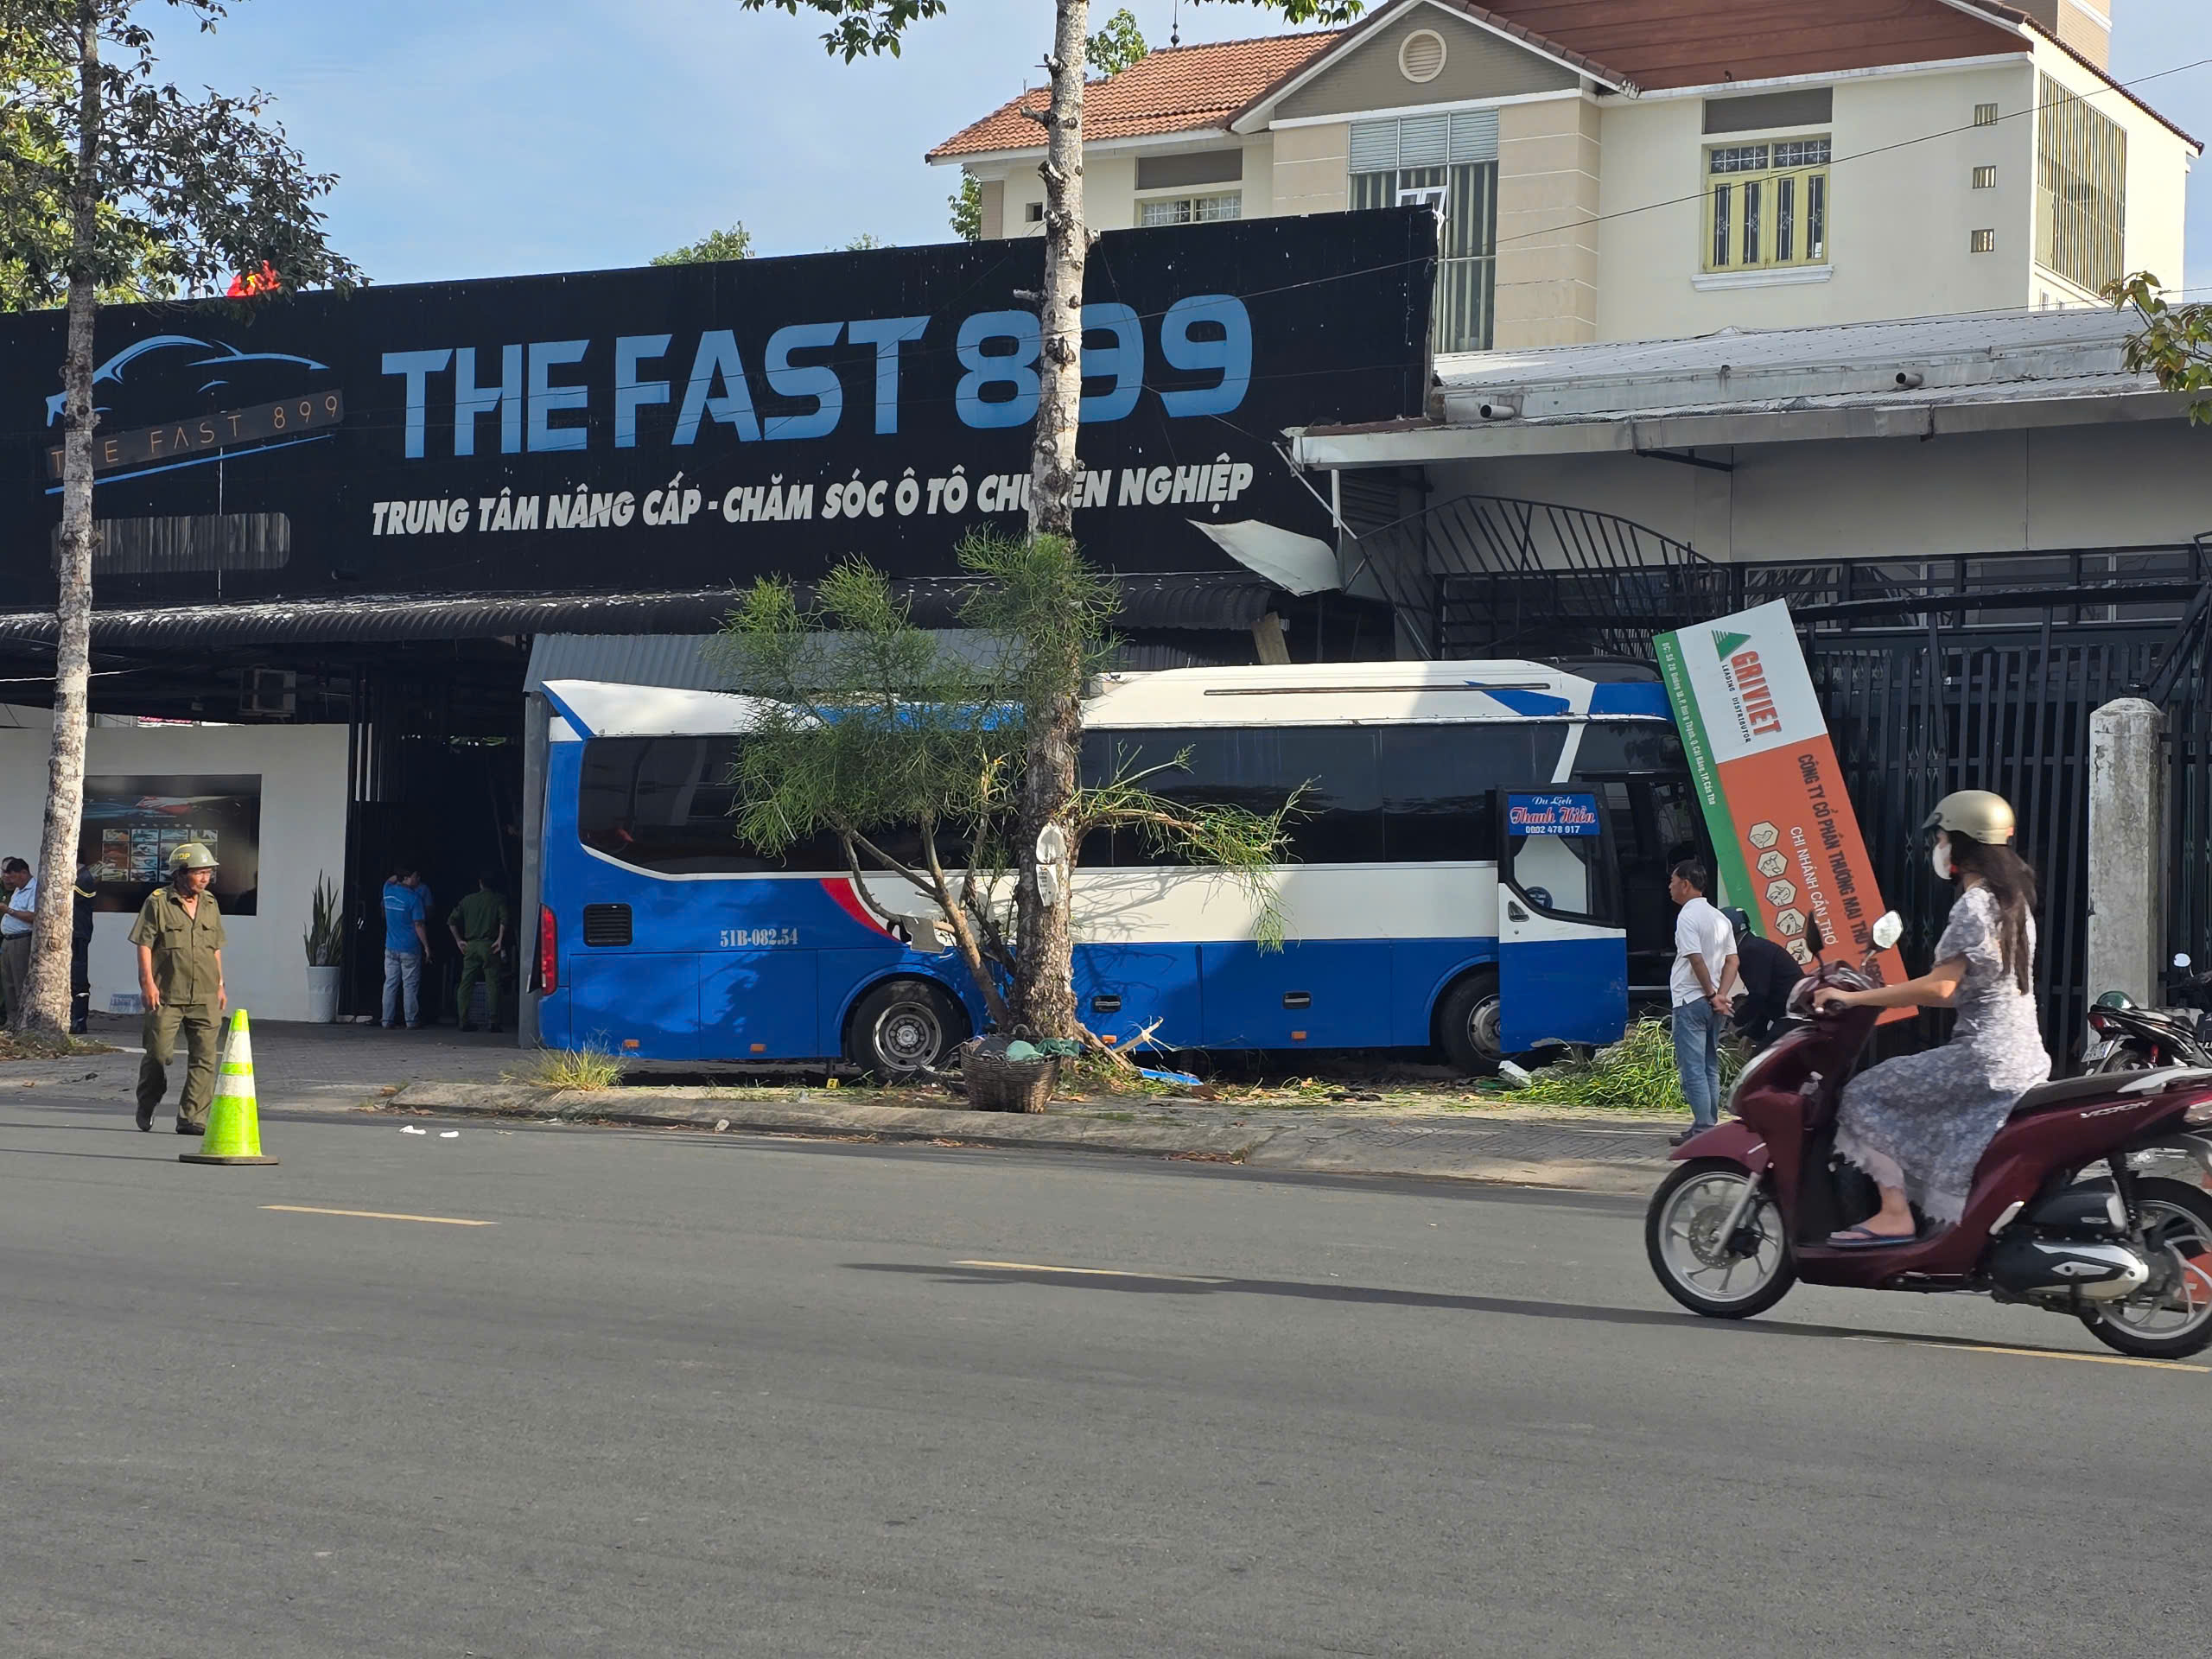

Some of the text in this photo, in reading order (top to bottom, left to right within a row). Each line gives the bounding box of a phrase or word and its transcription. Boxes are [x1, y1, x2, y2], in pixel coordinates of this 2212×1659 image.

[382, 294, 1253, 459] THE FAST 899
[51, 395, 338, 473] TE FAST 899
[372, 498, 470, 536] TRUNG
[479, 486, 540, 531] TÂM
[546, 483, 635, 530] NÂNG
[642, 471, 702, 526] CẤP
[722, 473, 814, 523] CHĂM
[822, 468, 889, 519] SÓC
[894, 467, 919, 516] Ô
[926, 464, 969, 515] TÔ
[1117, 452, 1254, 514] NGHIỆP
[1721, 664, 1751, 743] LEADING DISTRIBUTOR
[1798, 753, 1820, 785] CÔNG
[1532, 797, 1548, 805] Du
[1807, 784, 1825, 799] TY
[1510, 806, 1556, 824] Thanh
[1790, 826, 1806, 847] CHI
[1797, 849, 1819, 890] NHÁNH
[720, 927, 798, 947] 51B-082.54
[1819, 920, 1839, 945] THƠ
